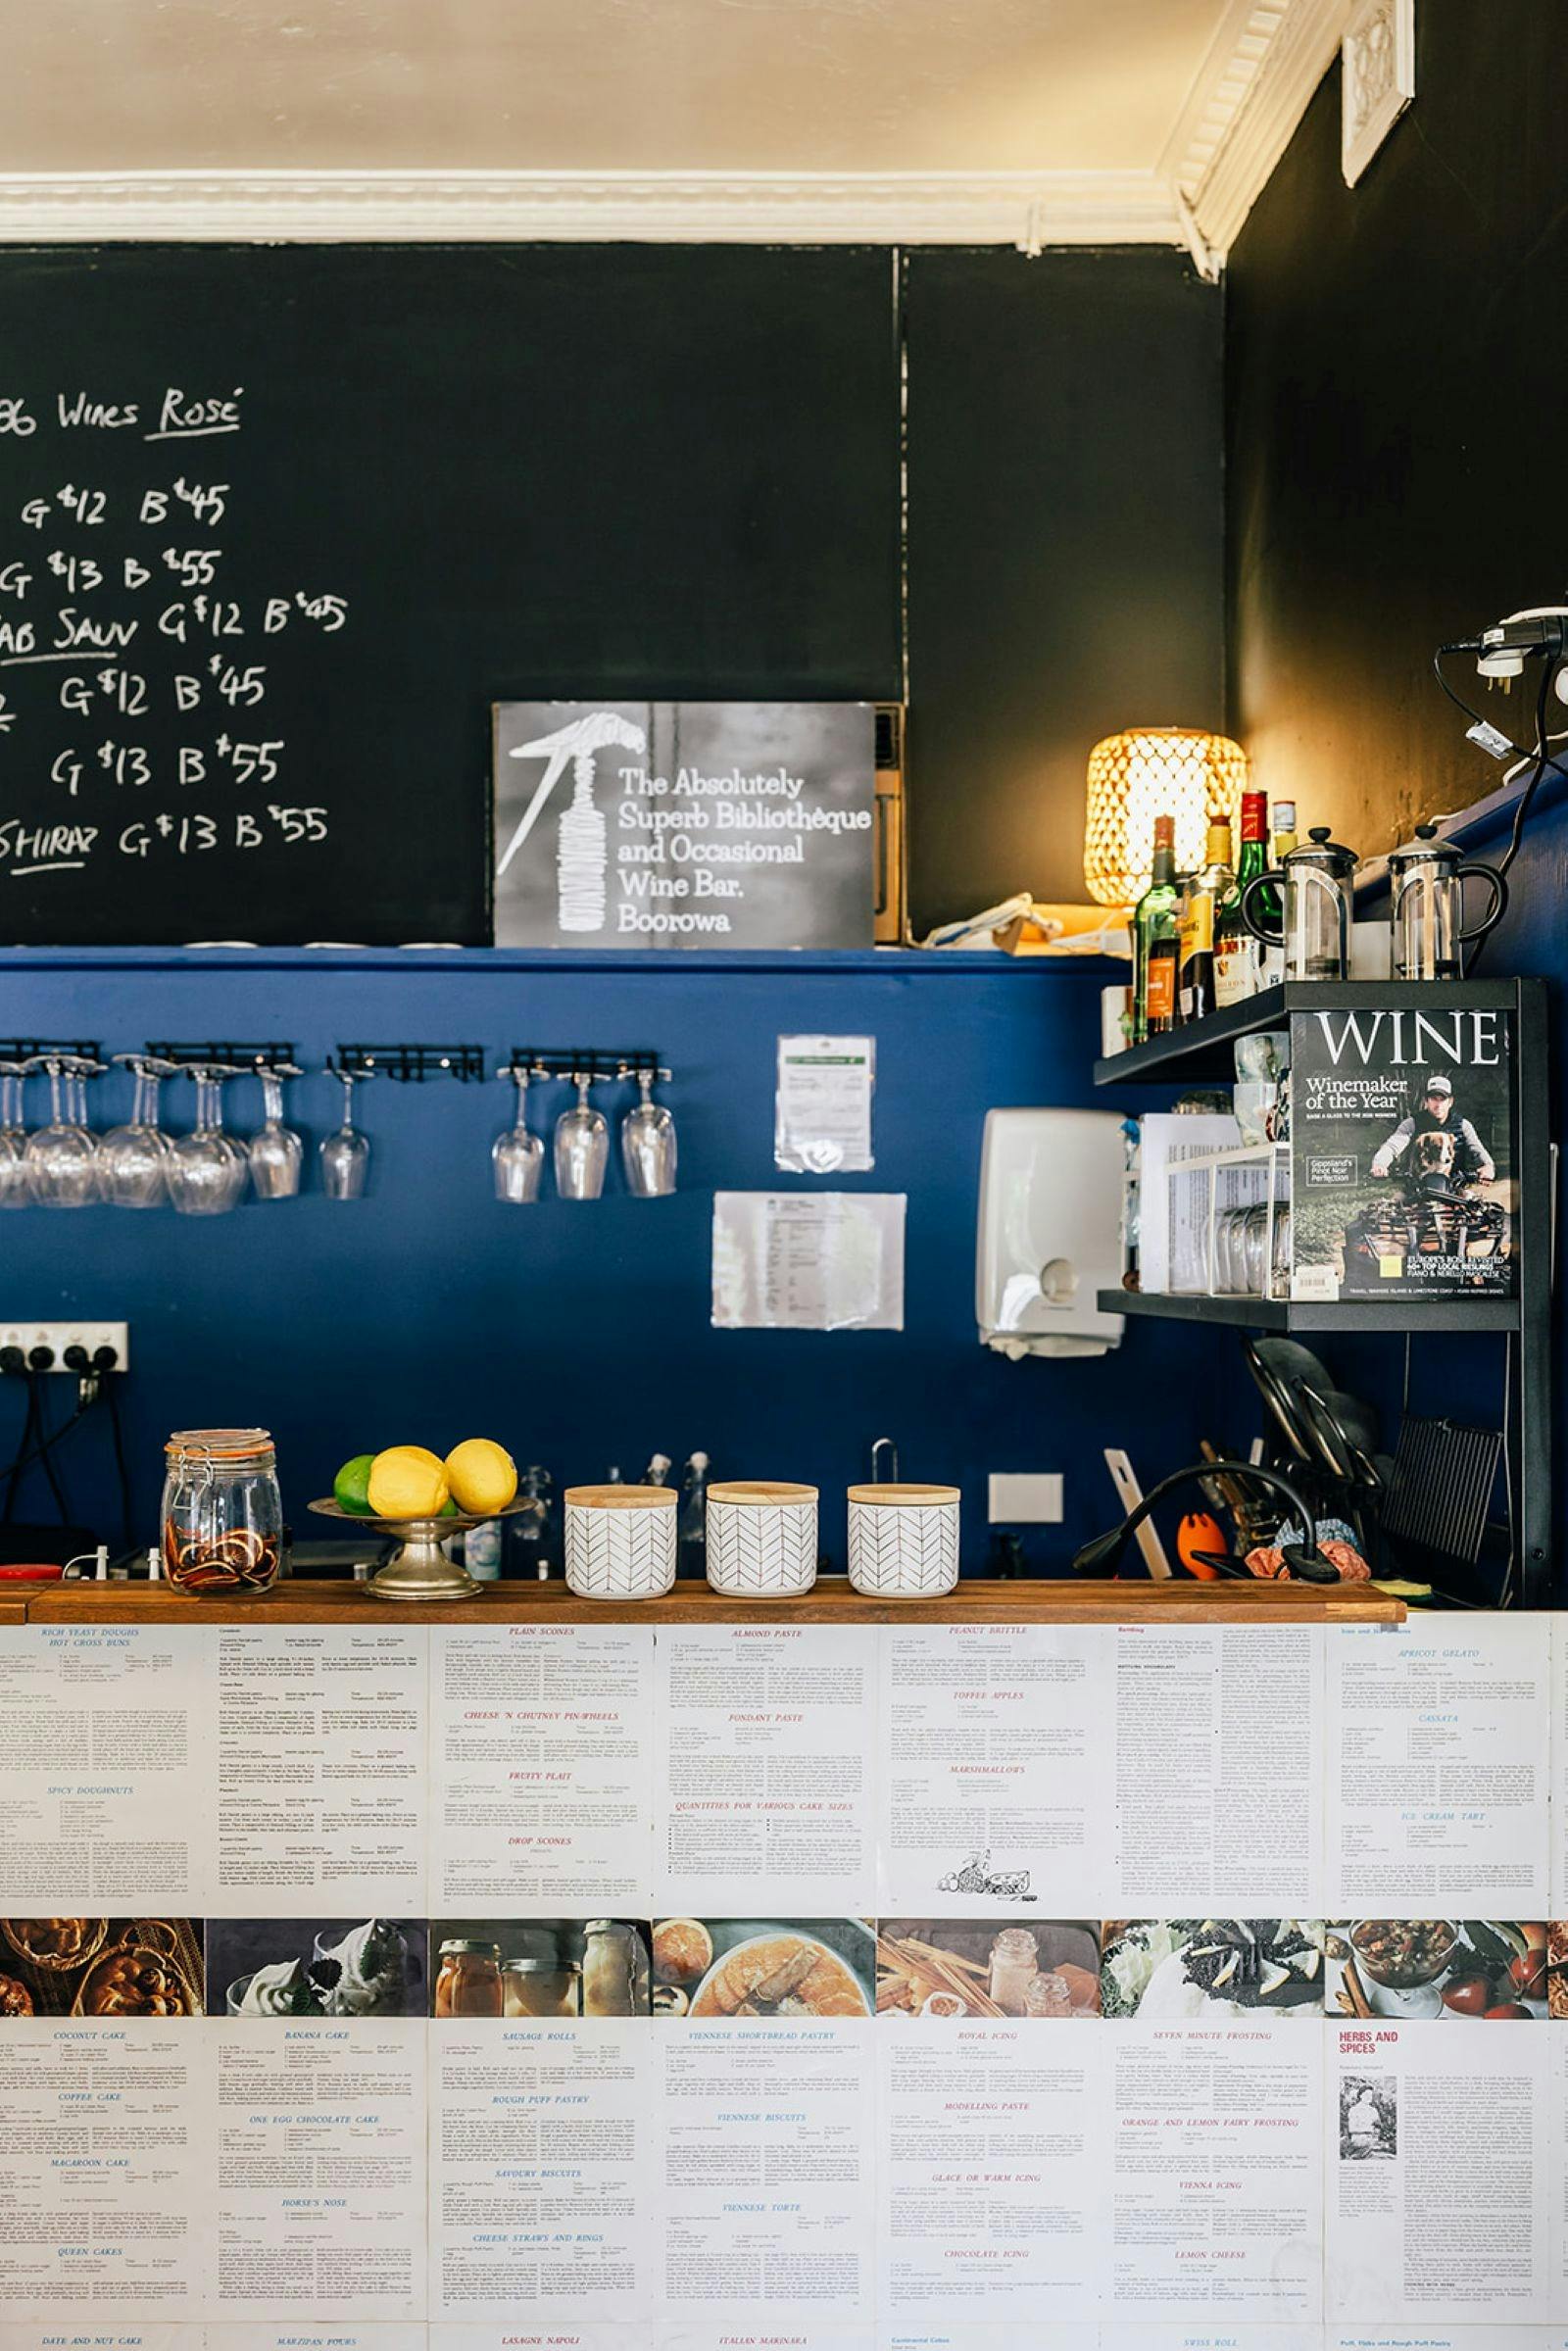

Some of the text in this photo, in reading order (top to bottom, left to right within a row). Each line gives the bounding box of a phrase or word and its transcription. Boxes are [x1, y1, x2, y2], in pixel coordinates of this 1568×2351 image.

[58, 392, 138, 428] Wines
[21, 477, 230, 529] G $12 B $45
[0, 547, 222, 600] G $13 B $55
[0, 591, 348, 654] AB SAUV G $12 B $45
[60, 654, 267, 716] G $12 B $45
[51, 733, 284, 796] G $13 B $55
[617, 767, 804, 800] The Absolutely
[617, 802, 872, 835] Superb Bibliothèque
[120, 823, 151, 857] G
[156, 814, 217, 853] $13
[235, 814, 263, 848] B
[268, 805, 328, 843] $55
[617, 835, 805, 863] and Occasional
[617, 868, 745, 899] Wine Bar.
[617, 903, 732, 933] Boorowa
[1313, 1010, 1499, 1066] WINE
[1305, 1075, 1408, 1094] Winemaker
[1305, 1092, 1398, 1110] of the Year
[41, 1628, 139, 1637] RICH YEAST DOUGHS
[49, 1639, 130, 1647] HOT CROSS BUNS
[1397, 1649, 1480, 1658] APRICOT GELATO
[464, 1711, 500, 1720] CHEESE
[516, 1711, 560, 1720] CHUTNEY
[728, 1713, 804, 1723] FONDANT PASTE
[1418, 1714, 1459, 1723] CASSATA
[509, 1772, 571, 1781] FRUITY PLAIT
[508, 1837, 572, 1845] DROP SCONES
[53, 2032, 126, 2040] COCONUT CAKE
[503, 2033, 576, 2041] SAUSAGE ROLLS
[688, 2032, 834, 2040] VIENNESE SHORTBREAD PASTRY
[1152, 2032, 1272, 2040] SEVEN MINUTE FROSTING
[1339, 2031, 1398, 2042] HERBS AND
[1339, 2042, 1376, 2054] SPICES
[58, 2092, 122, 2101] COFFEE CAKE
[492, 2095, 589, 2104] ROUGH PUFF PASTRY
[944, 2102, 1030, 2111] MODELLING PASTE
[249, 2115, 379, 2124] ONE EGG CHOCOLATE CAKE
[717, 2113, 807, 2123] VIENNESE BISCUITS
[50, 2159, 130, 2168] MACAROON CAKE
[495, 2169, 582, 2179] SAVOURY BISCUITS
[965, 2174, 980, 2182] OR
[983, 2174, 1011, 2182] WARM
[1014, 2174, 1042, 2182] ICING
[1179, 2180, 1243, 2189] VIENNA ICING
[281, 2198, 347, 2207] HORSE'S NOSE
[721, 2203, 802, 2212] VIENNESE TORTE
[471, 2233, 604, 2243] CHEESE STRAWS AND RINGS
[57, 2247, 122, 2256] QUEEN CAKES
[1174, 2250, 1247, 2259] LEMON CHEESE
[41, 2336, 143, 2345] DATE AND NUT CAKE
[501, 2336, 580, 2345] LASAGNE NAPOLI
